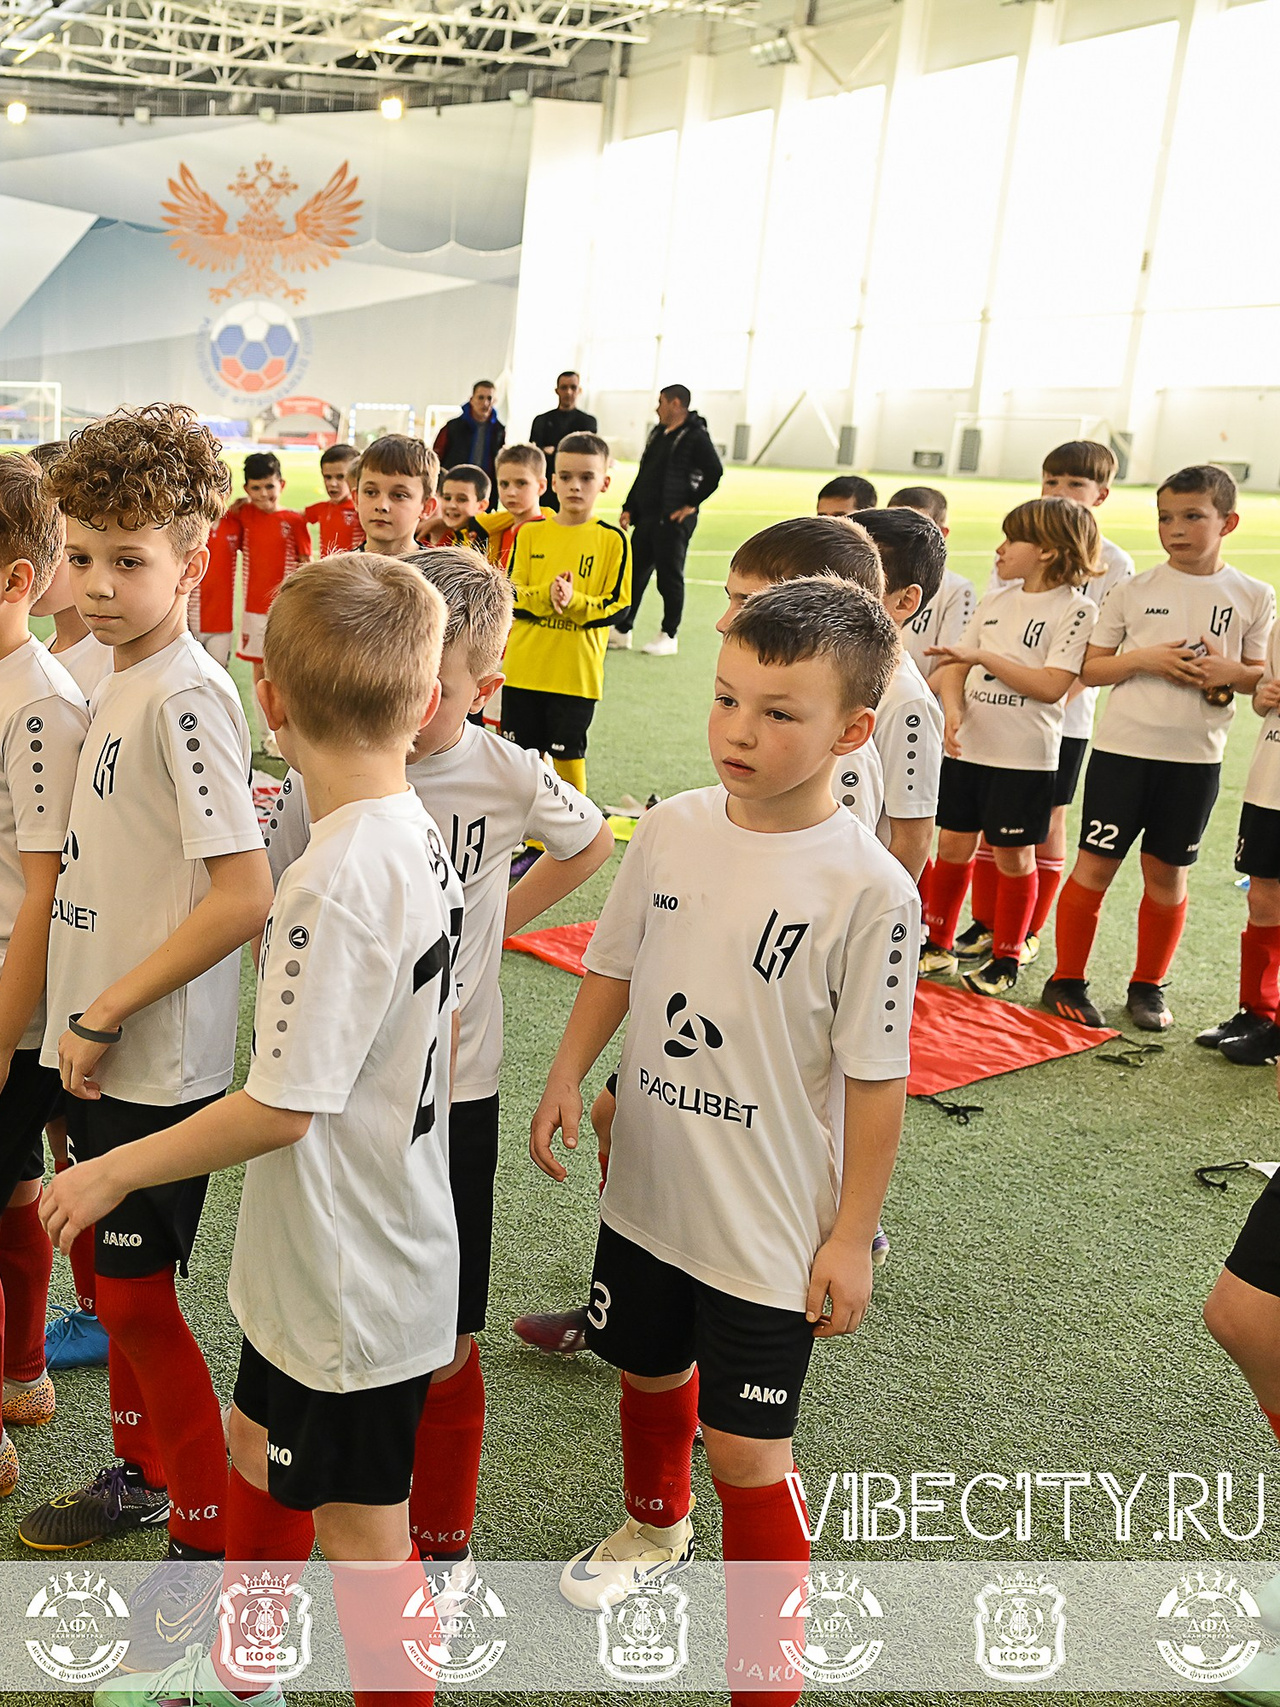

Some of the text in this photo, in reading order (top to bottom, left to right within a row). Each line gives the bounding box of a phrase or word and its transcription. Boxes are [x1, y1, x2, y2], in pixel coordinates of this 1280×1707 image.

[1144, 607, 1170, 616] JAKO
[1085, 819, 1121, 851] 22
[639, 1067, 759, 1130] РАСЦВЕТ
[102, 1229, 143, 1248] JAKO
[739, 1383, 789, 1405] JAKO
[112, 1411, 142, 1426] KO
[266, 1440, 293, 1467] KO
